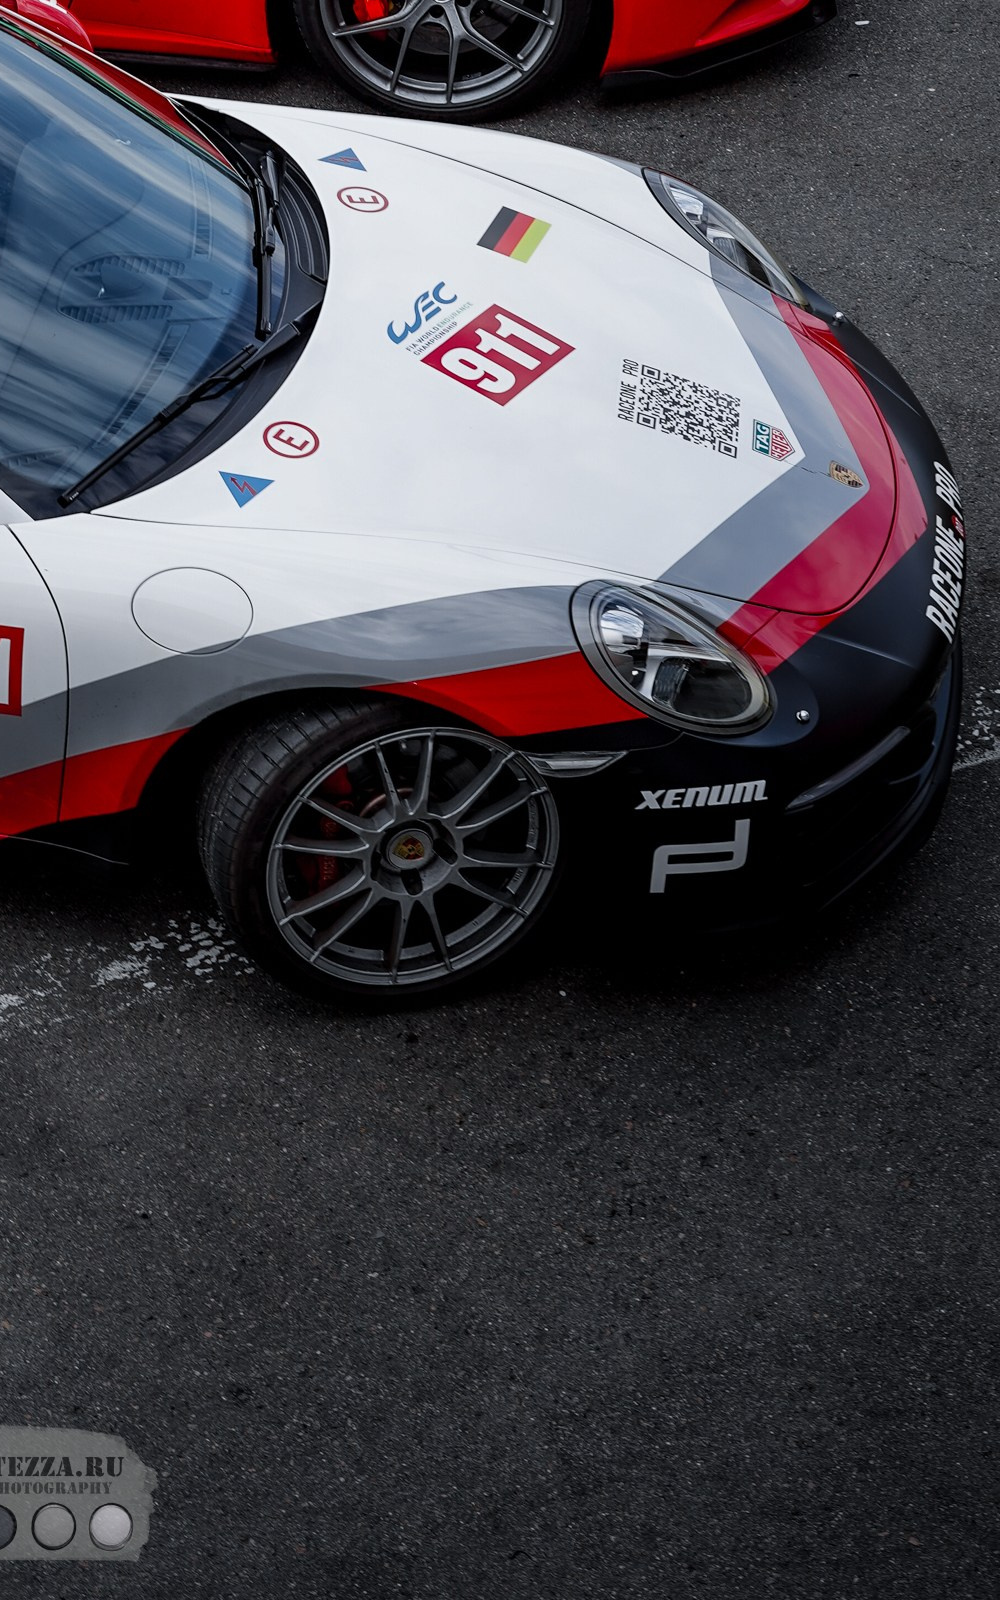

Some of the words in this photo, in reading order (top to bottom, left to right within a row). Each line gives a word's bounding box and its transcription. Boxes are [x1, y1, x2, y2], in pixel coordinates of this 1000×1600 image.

[387, 281, 458, 345] WEC
[405, 341, 418, 352] FIA
[416, 325, 440, 345] WORLD
[436, 301, 474, 329] ENDURANCE
[413, 321, 459, 356] CHAMPIONSHIP
[440, 313, 561, 394] 911
[622, 358, 639, 377] PRO
[618, 381, 637, 422] RACEONE
[756, 424, 770, 450] TAG
[771, 428, 791, 459] HEUER
[933, 460, 964, 521] PRO
[925, 514, 965, 645] RACEONE
